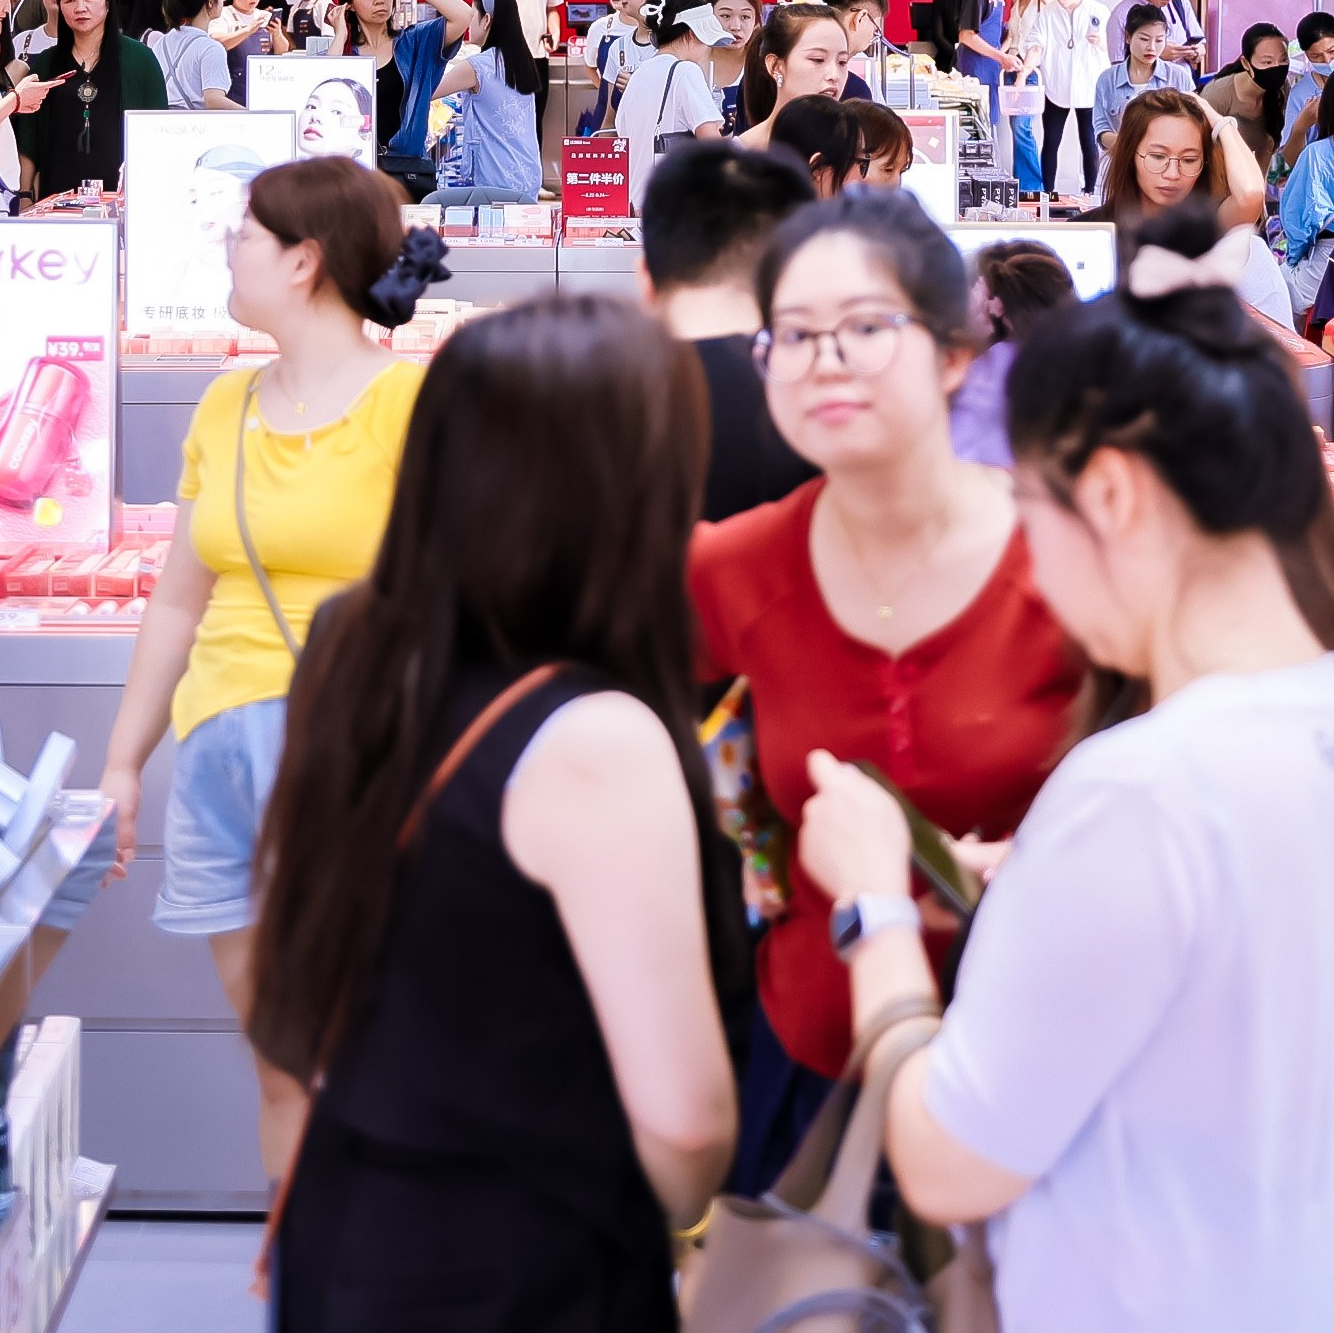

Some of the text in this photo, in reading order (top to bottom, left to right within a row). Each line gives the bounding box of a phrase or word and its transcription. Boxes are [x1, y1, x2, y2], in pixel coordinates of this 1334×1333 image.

[566, 172, 624, 185] 第二件半价
[143, 306, 206, 320] 专研底妆
